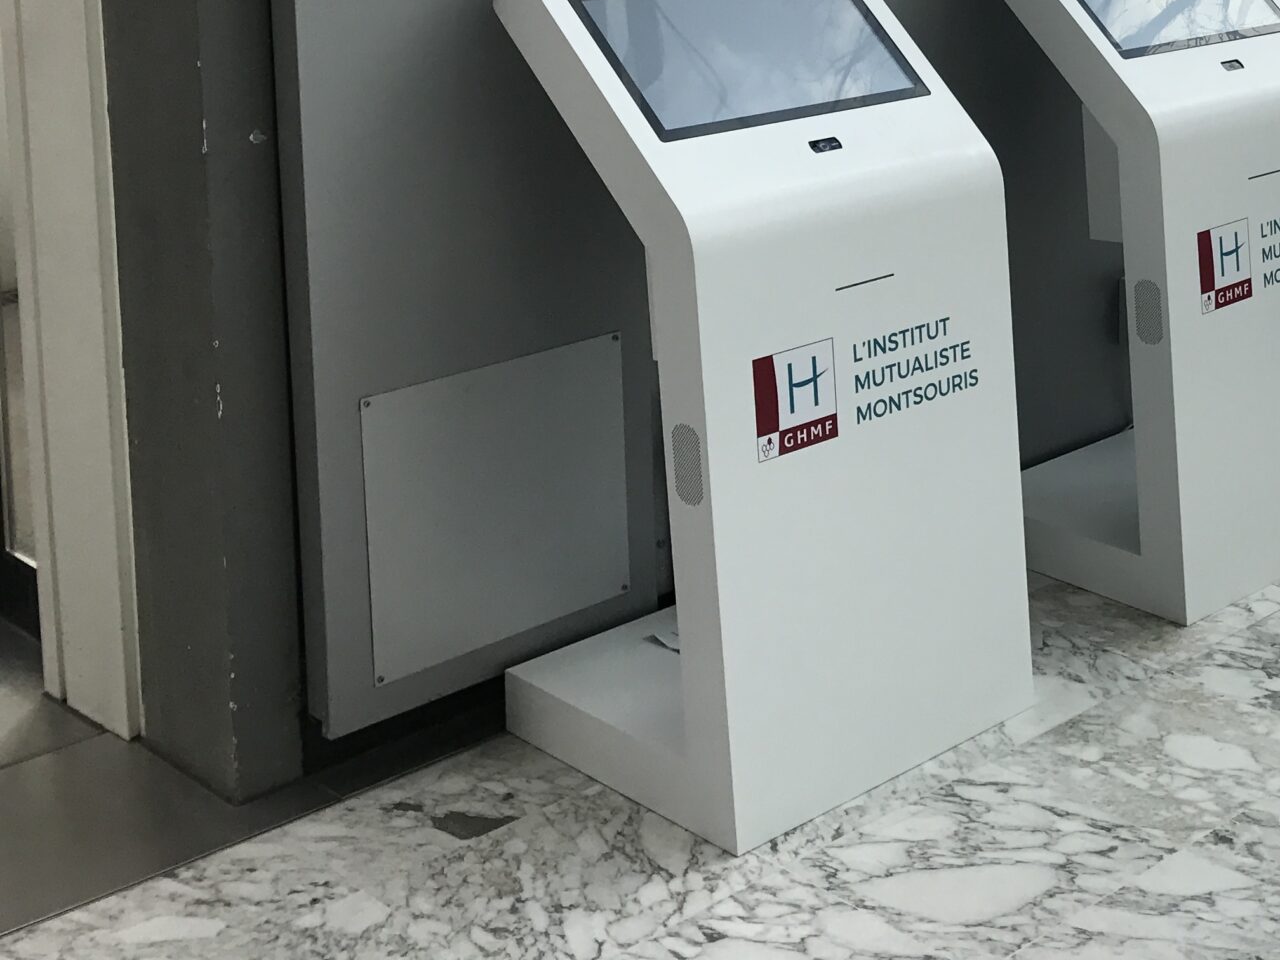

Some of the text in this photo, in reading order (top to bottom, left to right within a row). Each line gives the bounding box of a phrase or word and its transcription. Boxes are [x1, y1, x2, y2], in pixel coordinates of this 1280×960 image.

[1218, 283, 1249, 304] GHMF
[853, 317, 950, 363] L'INSTITUT
[854, 341, 972, 393] MUTUALISTE
[856, 368, 979, 424] MONTSOURIS
[784, 420, 834, 447] GHMF
